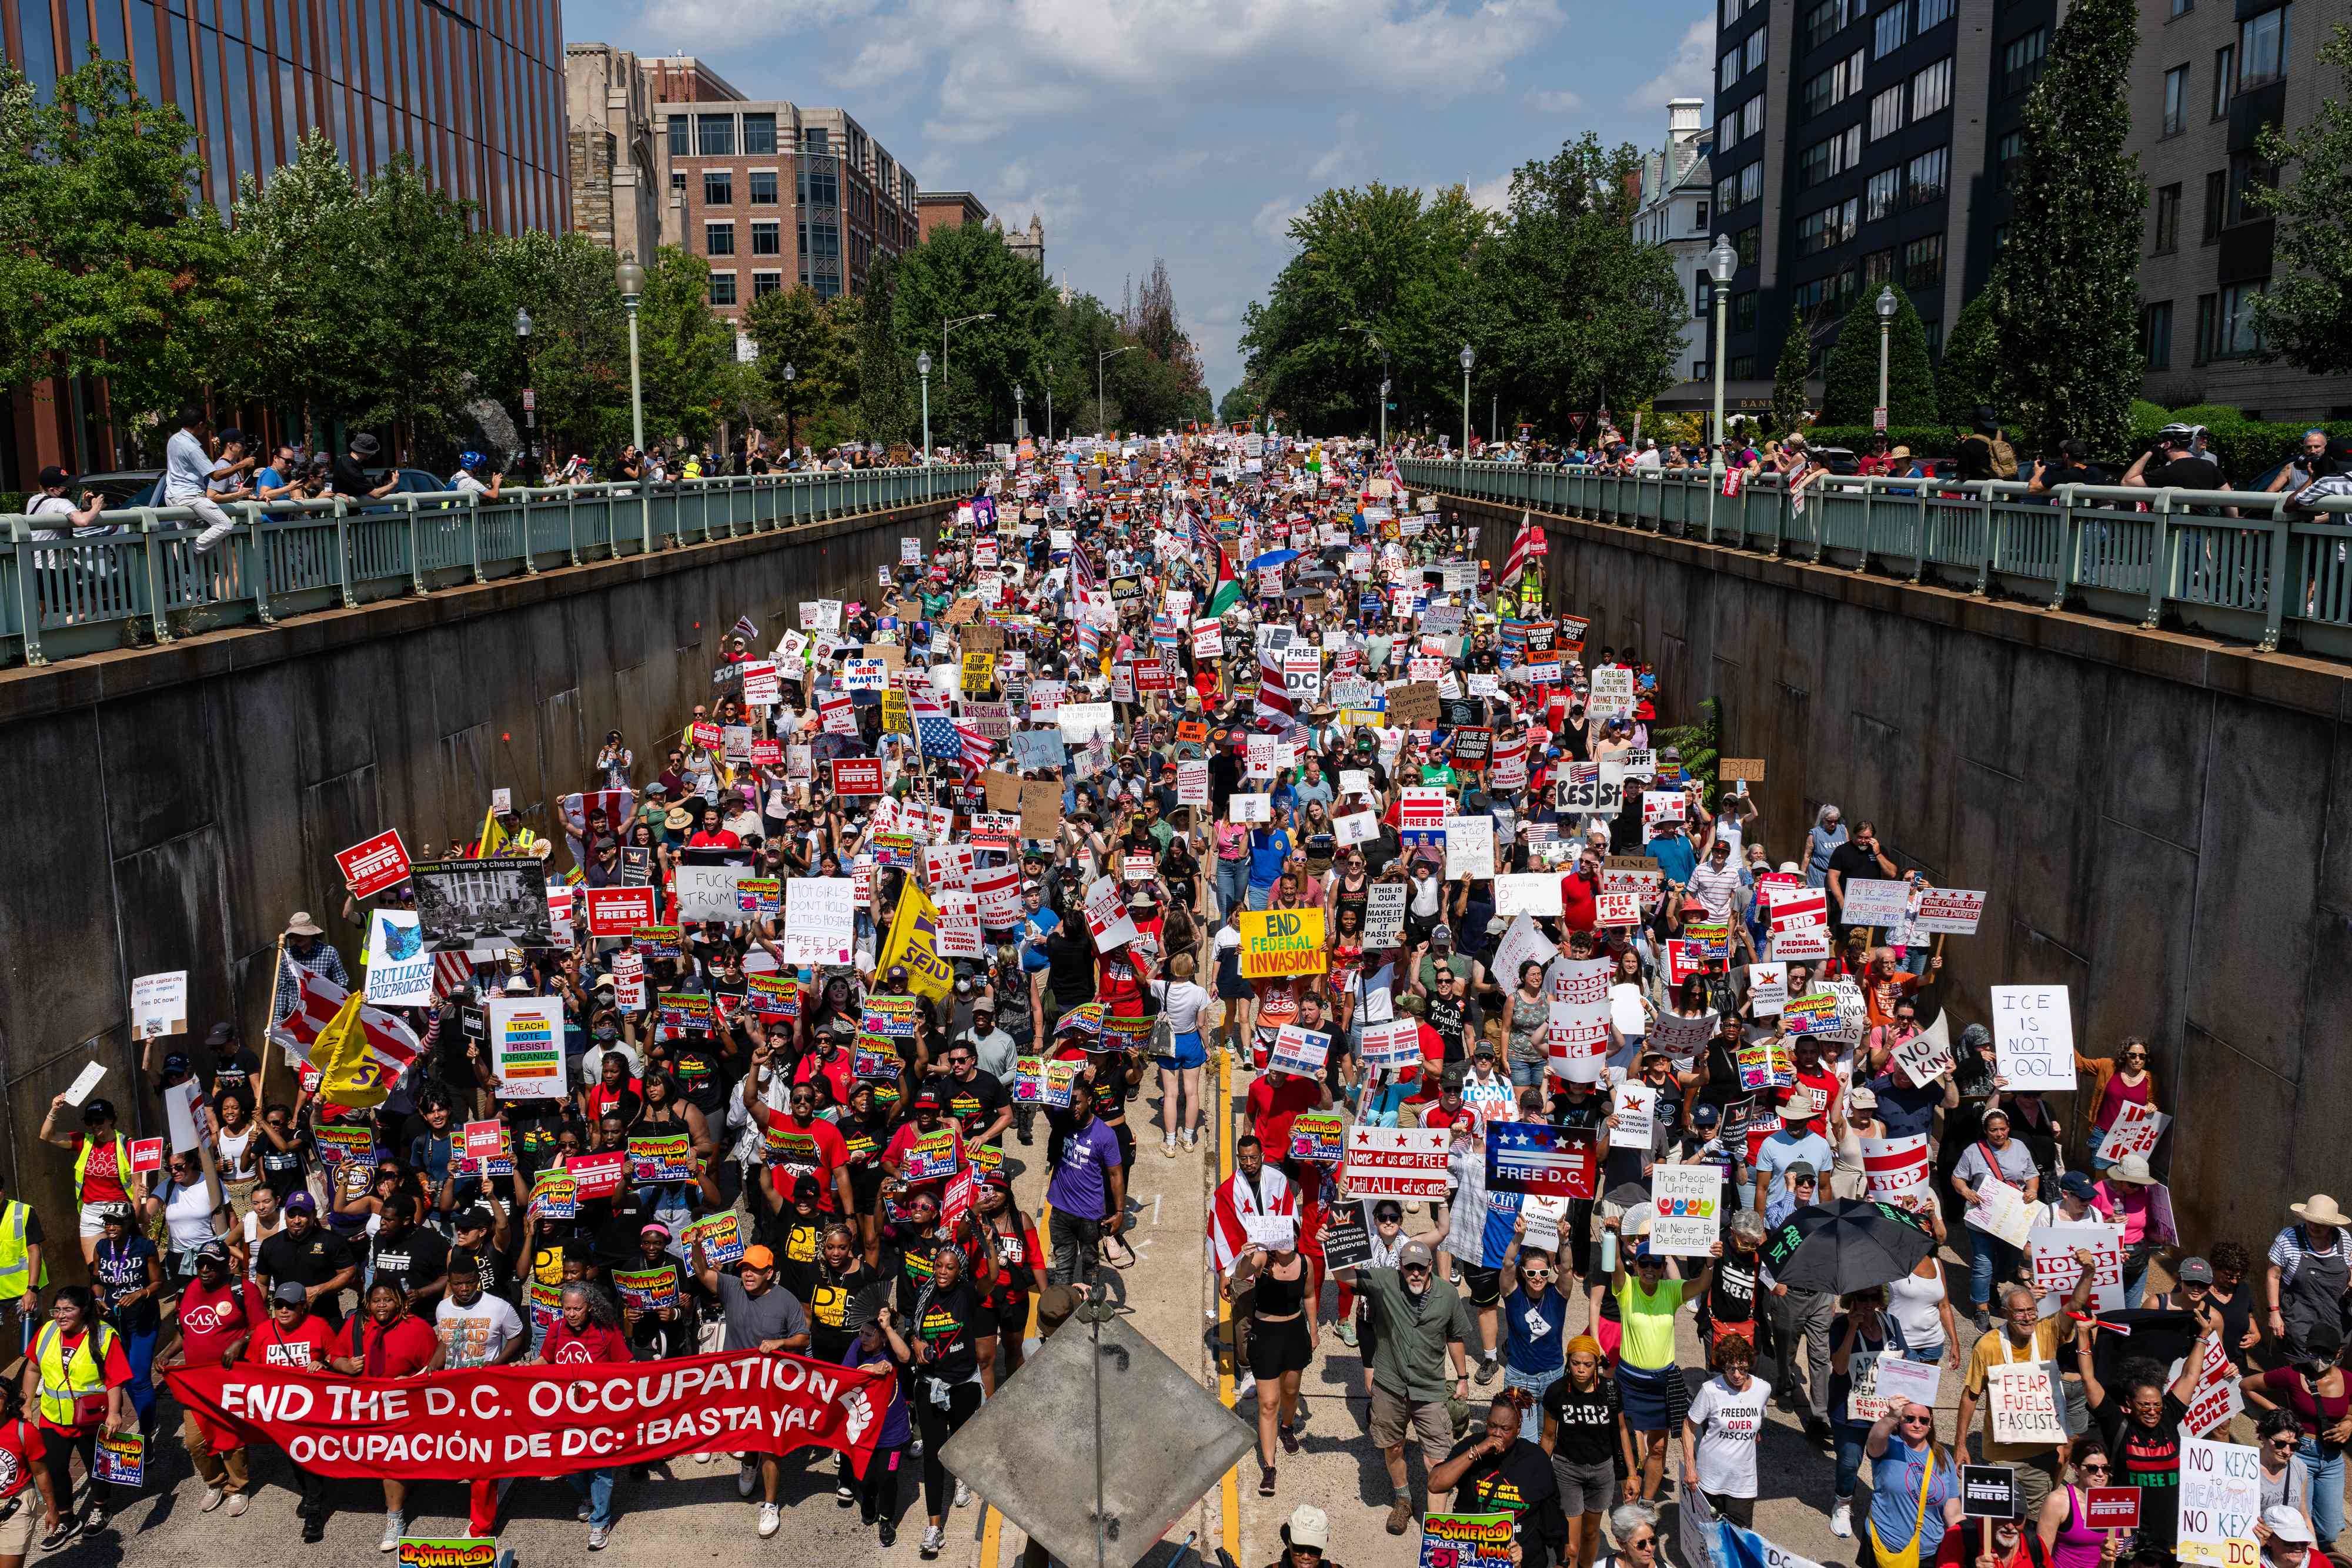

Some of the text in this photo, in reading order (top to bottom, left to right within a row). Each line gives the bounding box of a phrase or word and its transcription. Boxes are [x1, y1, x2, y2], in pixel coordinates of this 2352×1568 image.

[1381, 559, 1402, 569] FREE
[1114, 586, 1142, 599] NOPE.
[1429, 607, 1459, 617] STOP
[1197, 633, 1217, 643] STOP
[1526, 628, 1553, 636] TRUMP
[1530, 636, 1551, 644] MUST
[1533, 652, 1554, 660] NOW!
[966, 663, 990, 671] TRUMP'S
[964, 673, 988, 681] TAKEOVER
[1286, 673, 1317, 689] DC
[1593, 696, 1630, 705] ORANGE TRASH
[964, 706, 1009, 718] RESISTANCE
[1456, 741, 1488, 750] LARGUE
[1456, 749, 1484, 758] TRUMP
[410, 864, 439, 873] Pawns
[442, 862, 450, 871] in
[489, 860, 514, 870] chess
[517, 859, 540, 869] game
[1606, 884, 1653, 892] STATEHOOD
[948, 906, 965, 915] WE
[1088, 893, 1119, 922] FUERA
[1924, 898, 1983, 910] ONE CAPITAL CITY
[596, 910, 647, 920] FREE DC
[1102, 910, 1119, 927] ICE
[1923, 909, 1978, 920] UNDER DURESS
[943, 917, 974, 928] HAVE
[1266, 912, 1301, 937] END
[1784, 914, 1816, 931] END
[1251, 935, 1314, 953] FEDERAL
[1781, 939, 1820, 947] FEDERAL
[1776, 947, 1825, 955] OCCUPATION
[900, 947, 950, 980] SEIU
[1250, 951, 1321, 973] INVASION
[392, 978, 431, 996] PROCESS
[1265, 1000, 1296, 1011] GO-GO
[2003, 994, 2051, 1009] ICE
[2021, 1017, 2039, 1031] IS
[2009, 1038, 2049, 1051] NOT
[505, 1052, 555, 1061] ORGANIZE
[1999, 1054, 2073, 1076] COOL!
[1348, 1152, 1446, 1168] None of us are FREE
[1496, 1166, 1585, 1185] FREE D.C.
[1658, 1171, 1715, 1183] The People
[1873, 1170, 1921, 1190] STOP
[1347, 1178, 1446, 1195] Until ALL of us are
[1665, 1183, 1703, 1195] United
[184, 1312, 222, 1326] CASA
[2004, 1373, 2050, 1393] FEAR
[220, 1357, 838, 1423] END THE D.C. OCCUPATION
[2004, 1393, 2052, 1411] FUELS
[2183, 1386, 2230, 1427] HOME
[1562, 1405, 1610, 1425] 2:02
[1720, 1407, 1759, 1417] FREEDOM
[2190, 1400, 2230, 1436] RULE
[1728, 1420, 1752, 1430] OVER
[1998, 1413, 2061, 1430] FASCISTS
[289, 1403, 822, 1463] OCUPACIÓN DE DC: ¡BASTA YA!
[1719, 1430, 1756, 1441] FASCISM
[2189, 1447, 2259, 1479] NO KEYS
[2210, 1476, 2221, 1486] to
[2183, 1510, 2252, 1538] NO KEY
[2193, 1542, 2254, 1566] to DC
